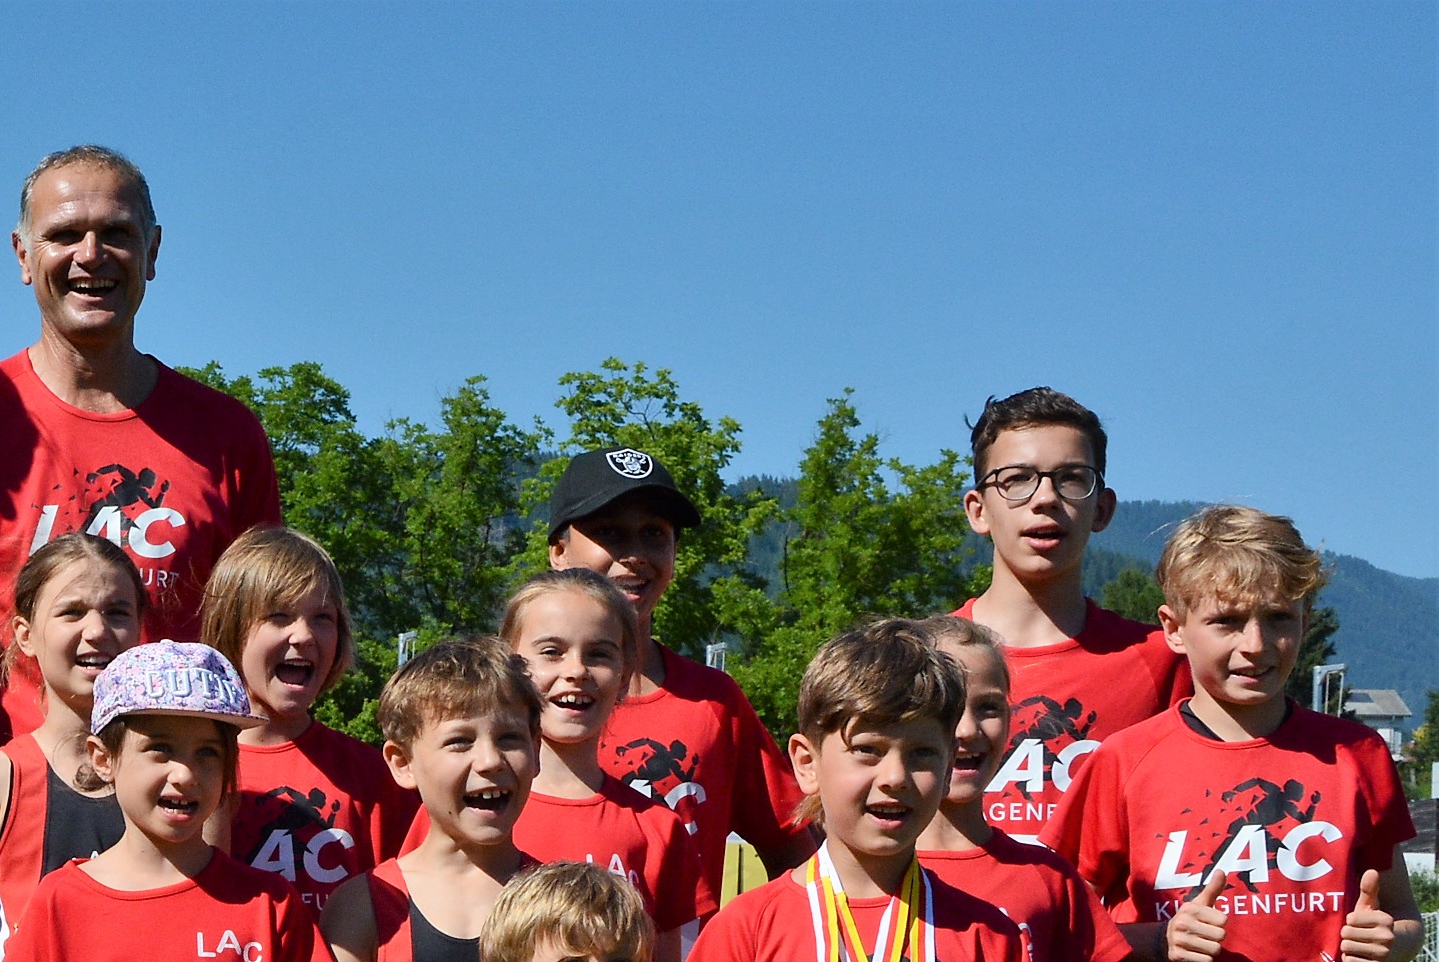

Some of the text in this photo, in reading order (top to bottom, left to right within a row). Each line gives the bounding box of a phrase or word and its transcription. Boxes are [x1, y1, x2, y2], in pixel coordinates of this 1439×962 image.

[984, 738, 1103, 793] AC
[250, 828, 355, 884] AC
[1154, 820, 1344, 890] LAC
[1155, 891, 1345, 921] KGENFURT
